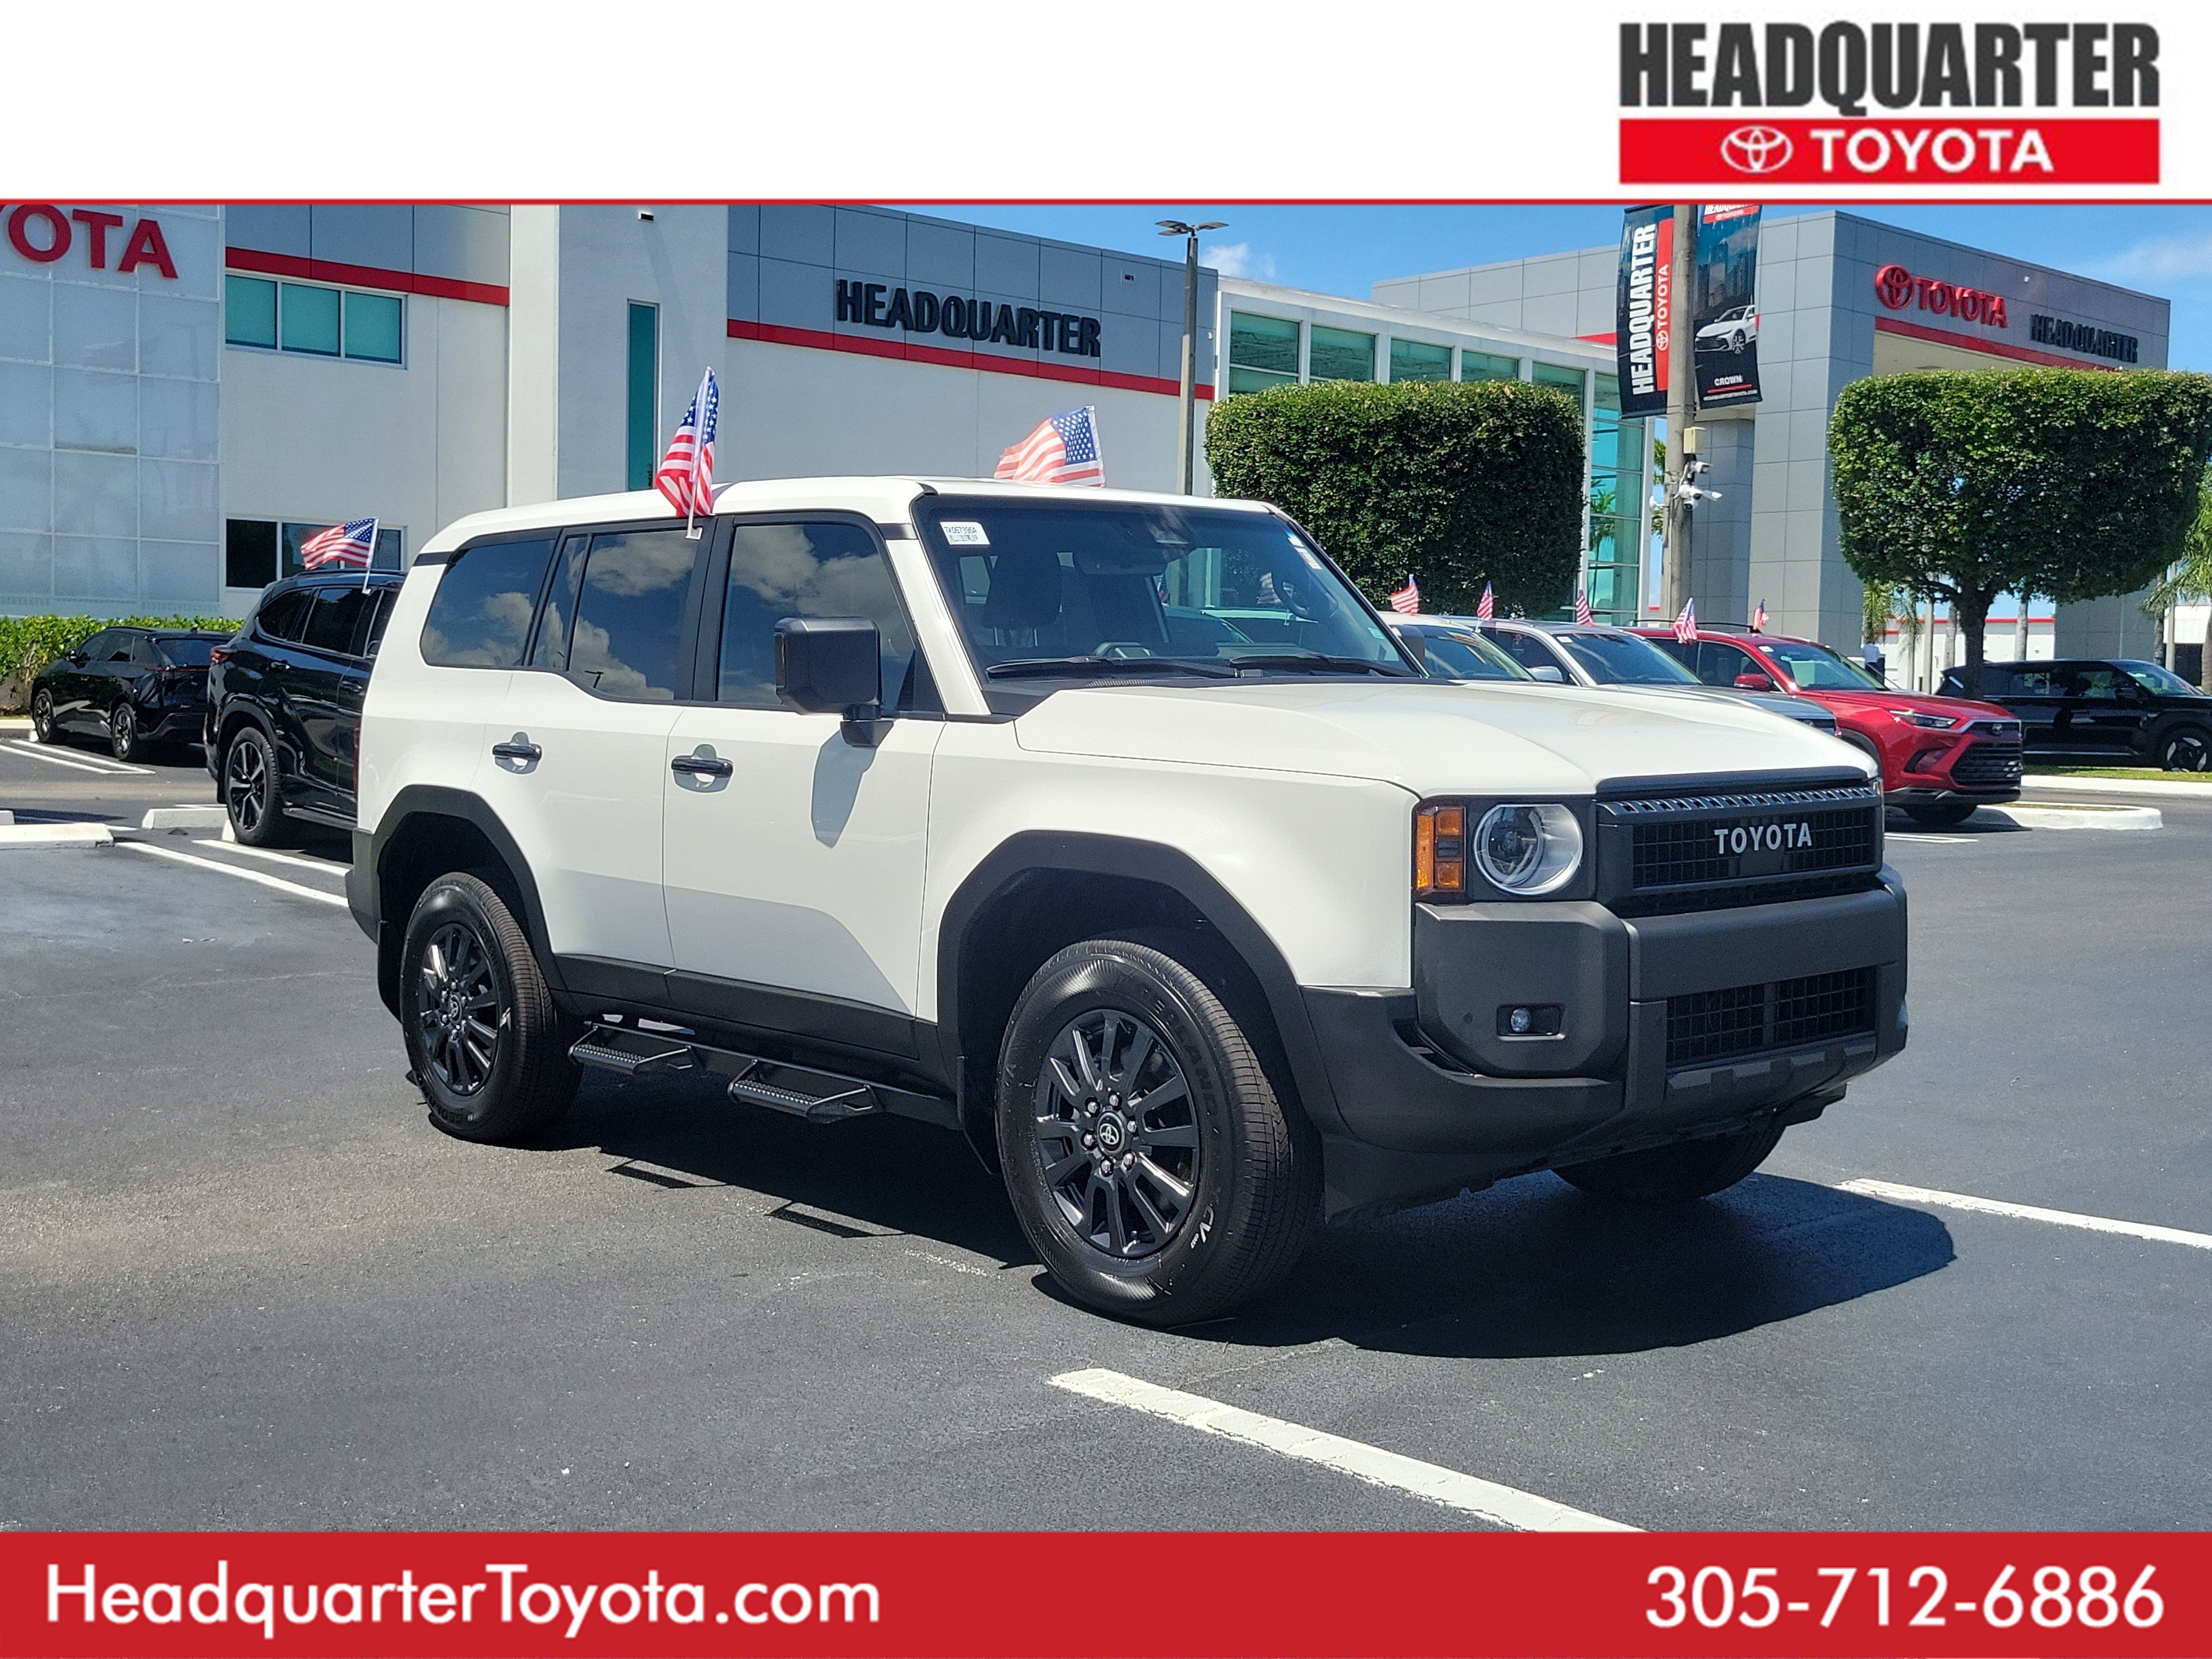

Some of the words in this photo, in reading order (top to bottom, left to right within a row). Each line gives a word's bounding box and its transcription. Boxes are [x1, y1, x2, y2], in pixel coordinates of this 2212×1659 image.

[0, 205, 179, 279] OTA
[837, 279, 1101, 358] HEADQUARTER
[1629, 223, 1656, 395] HEADQUARTER
[1657, 264, 1669, 329] TOYOTA
[1916, 276, 2007, 328] TOYOTA
[2031, 314, 2138, 364] HEADQUARTER
[1714, 374, 1742, 386] CROWN
[1714, 822, 1812, 854] TOYOTA
